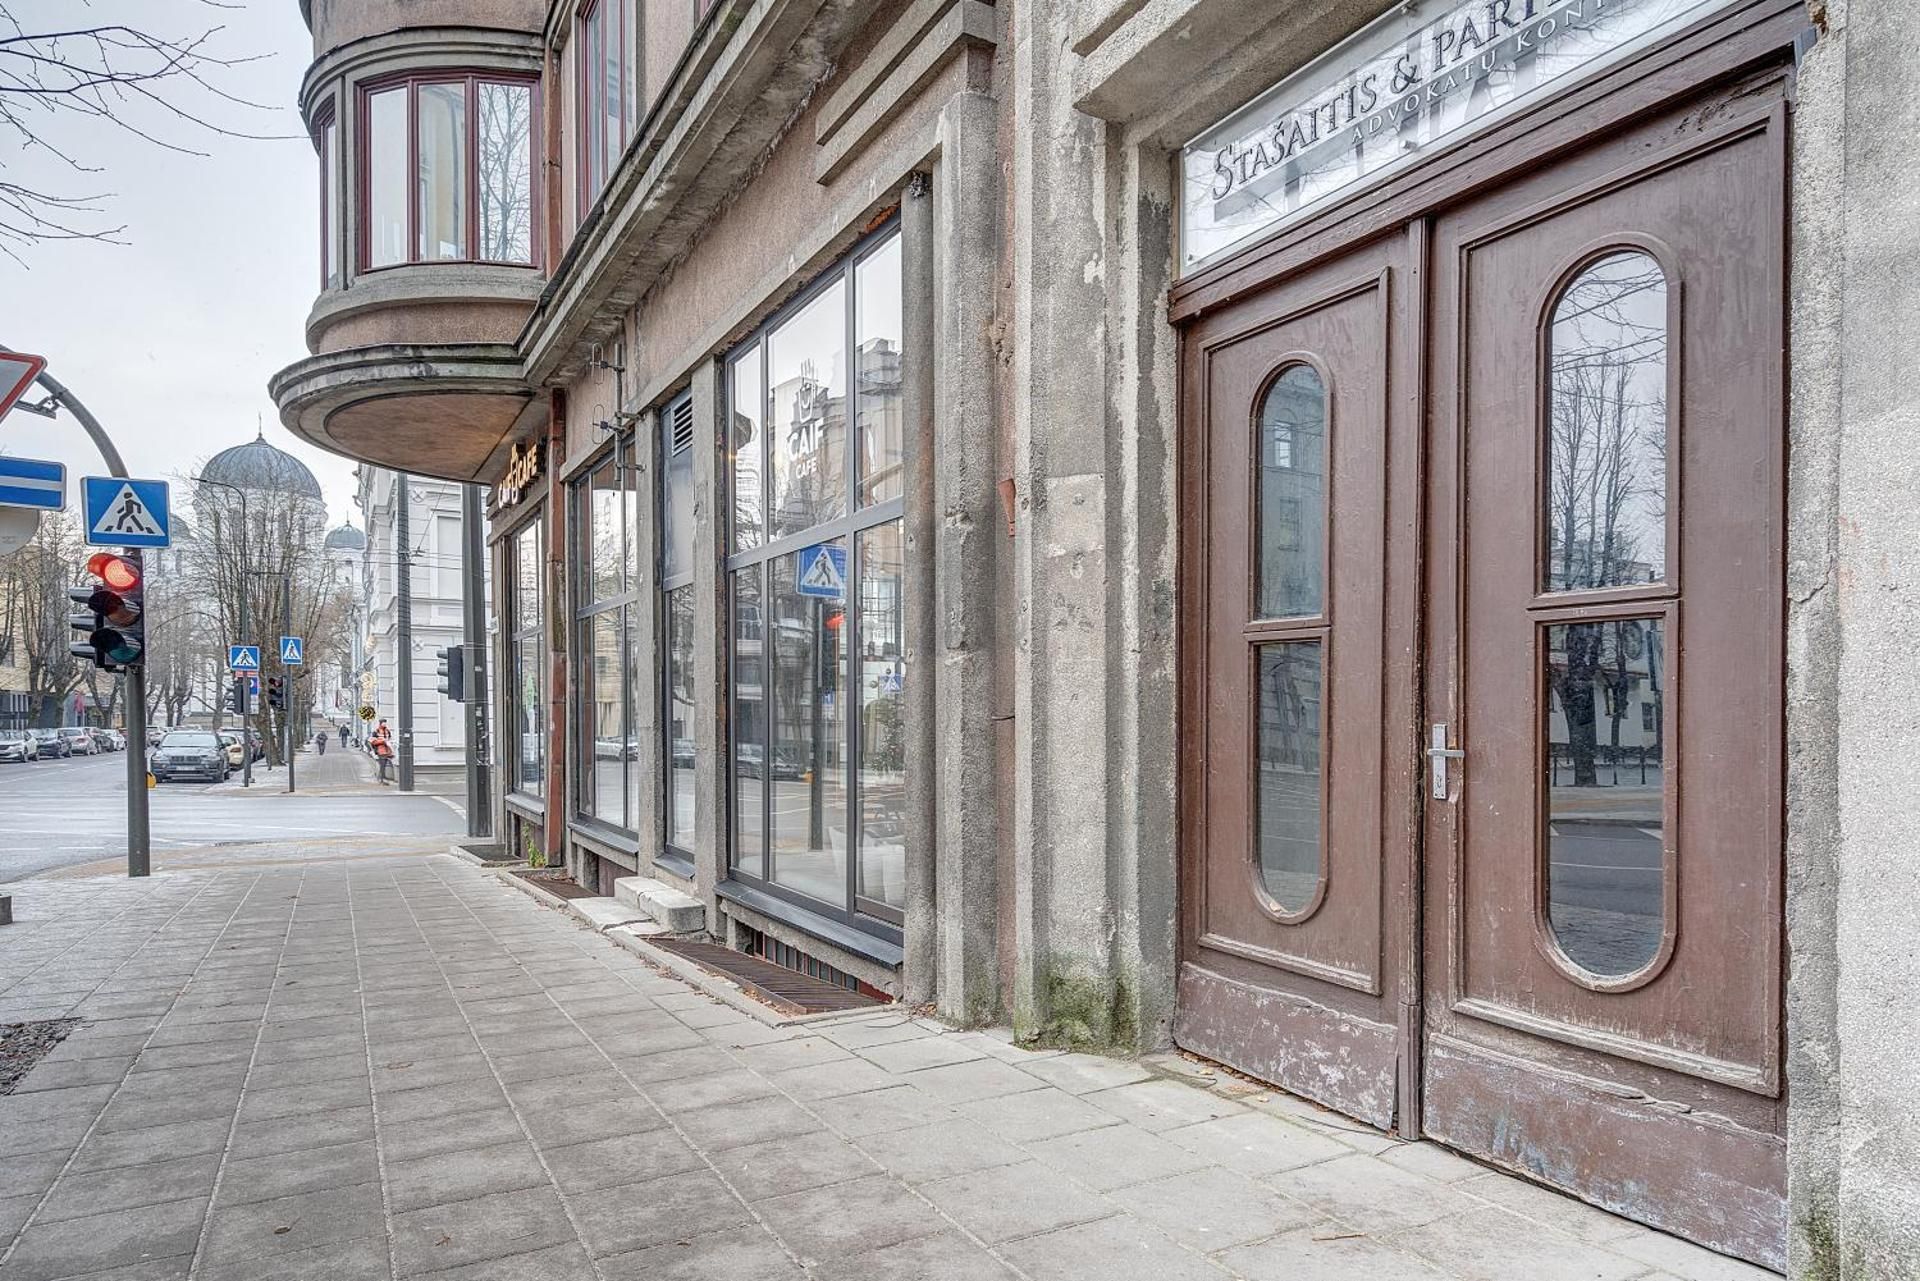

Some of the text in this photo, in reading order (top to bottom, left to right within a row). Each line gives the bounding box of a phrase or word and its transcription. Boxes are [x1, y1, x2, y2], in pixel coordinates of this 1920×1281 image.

[1211, 0, 1560, 200] STAŠAITIS & PAR
[1351, 48, 1498, 144] ADVOKATŲ
[787, 416, 824, 461] CAIF
[517, 443, 537, 488] CAFE
[796, 458, 817, 479] CAFE
